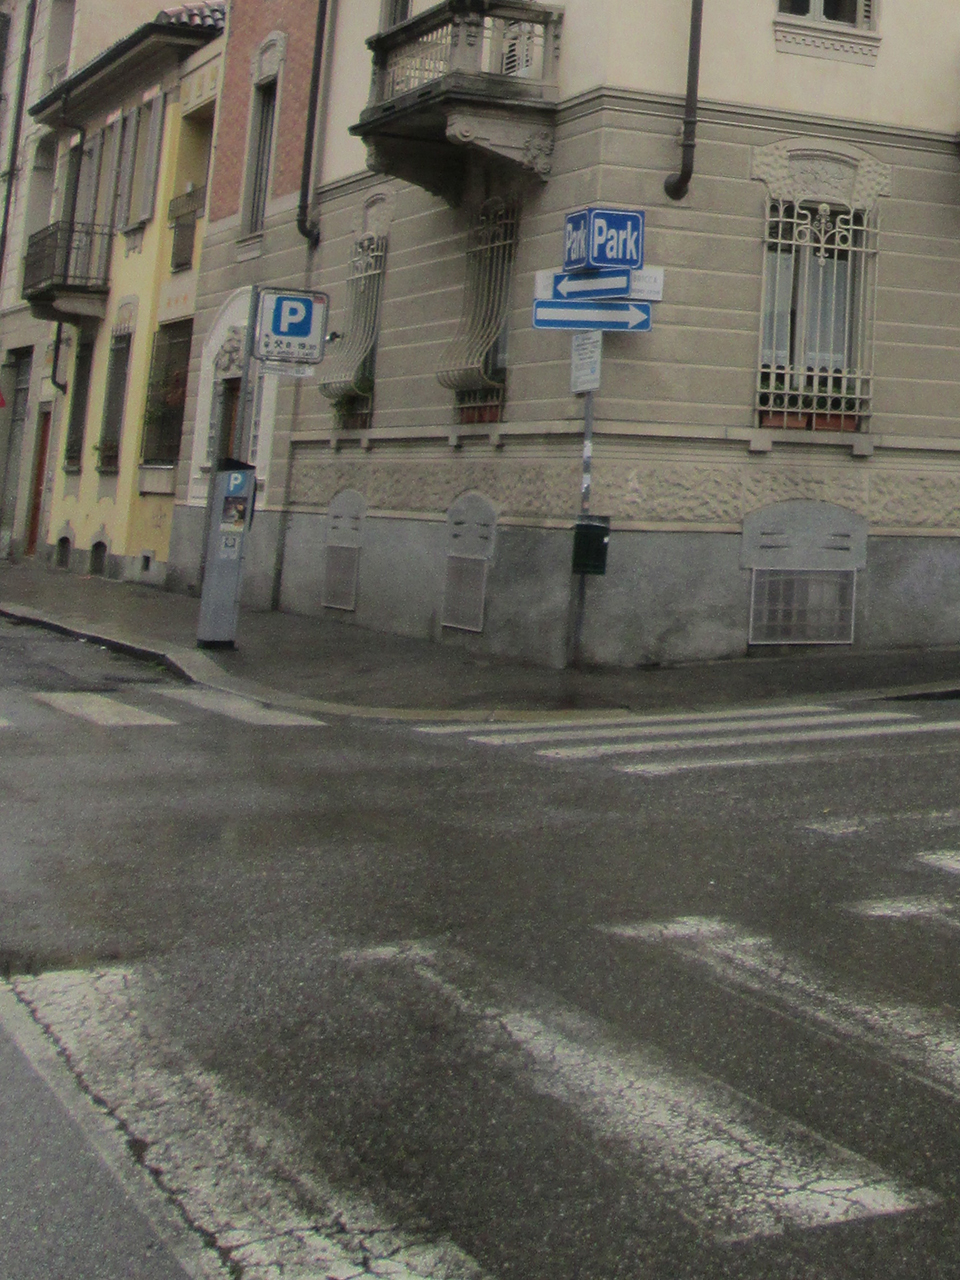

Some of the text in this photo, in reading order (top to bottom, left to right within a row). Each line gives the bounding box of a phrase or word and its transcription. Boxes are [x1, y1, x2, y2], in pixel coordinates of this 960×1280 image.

[565, 221, 587, 261] Park
[593, 218, 637, 260] Park
[280, 301, 306, 332] P
[229, 473, 243, 491] P
